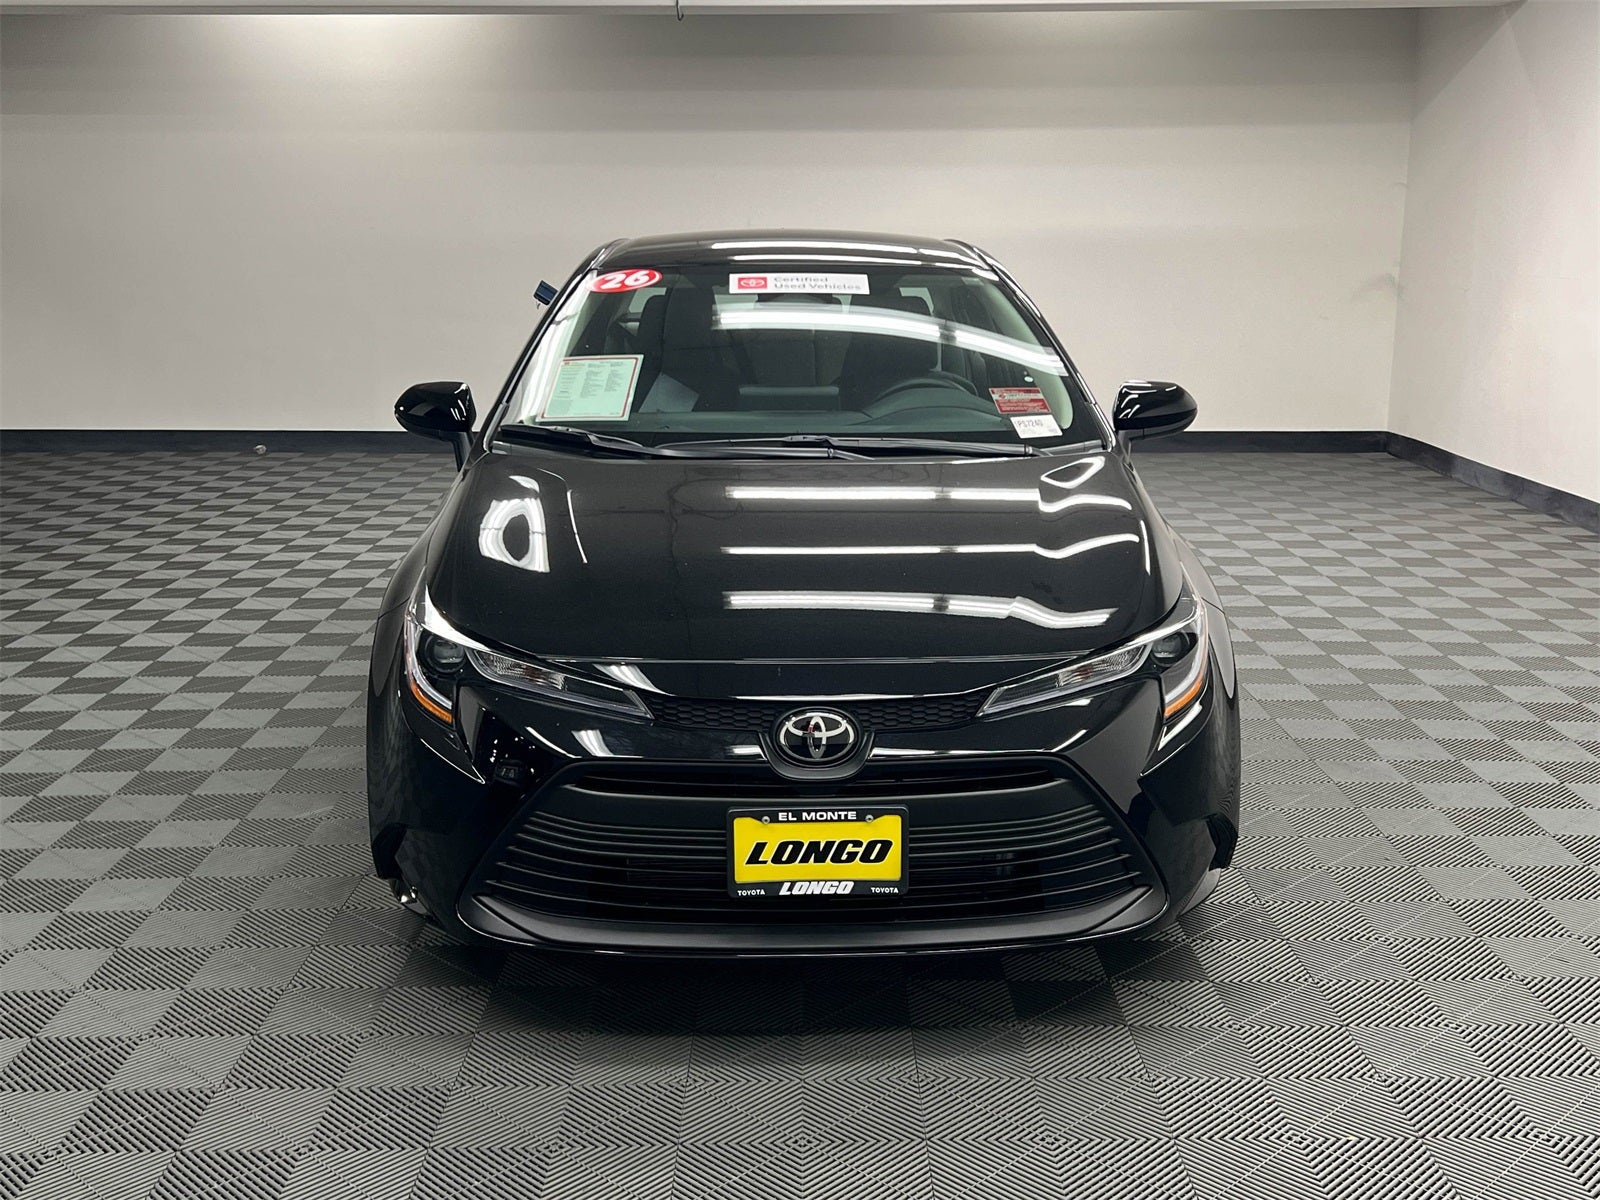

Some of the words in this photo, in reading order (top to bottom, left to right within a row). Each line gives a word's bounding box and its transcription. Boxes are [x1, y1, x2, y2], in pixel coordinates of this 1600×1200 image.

[600, 270, 650, 290] 26
[778, 812, 797, 821] EL
[802, 811, 857, 821] MONTE
[745, 839, 894, 865] LONGO
[779, 881, 855, 895] LONGO
